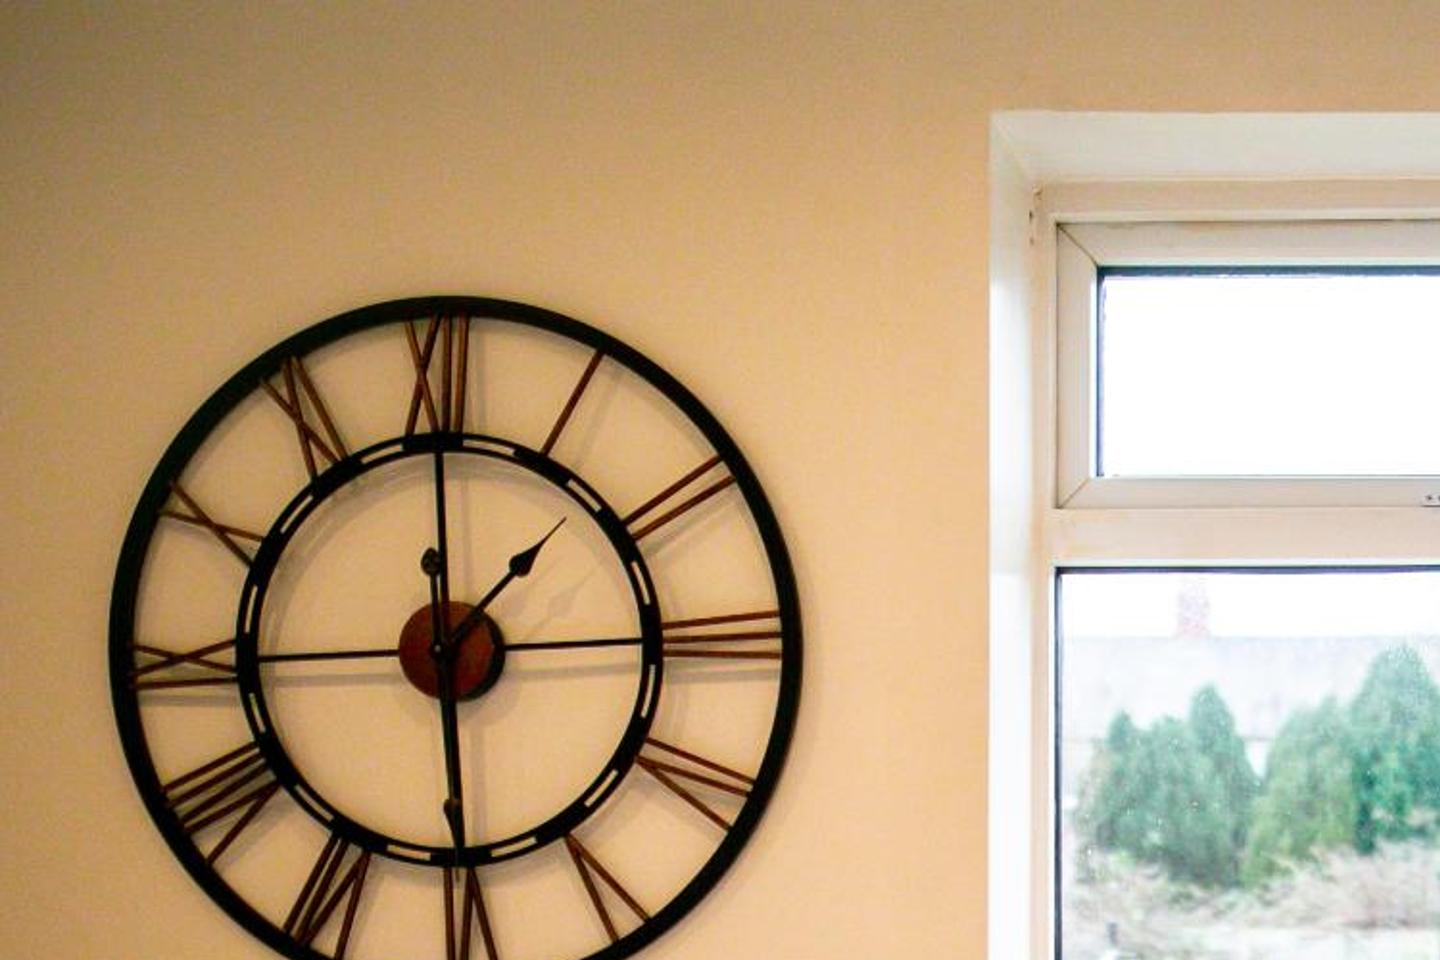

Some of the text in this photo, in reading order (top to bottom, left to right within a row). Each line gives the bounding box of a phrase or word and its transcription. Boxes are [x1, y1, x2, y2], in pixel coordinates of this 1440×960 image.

[261, 355, 351, 482] XI
[403, 316, 470, 435] XII
[130, 639, 239, 692] IX
[660, 610, 784, 660] III
[160, 742, 282, 866] VIII
